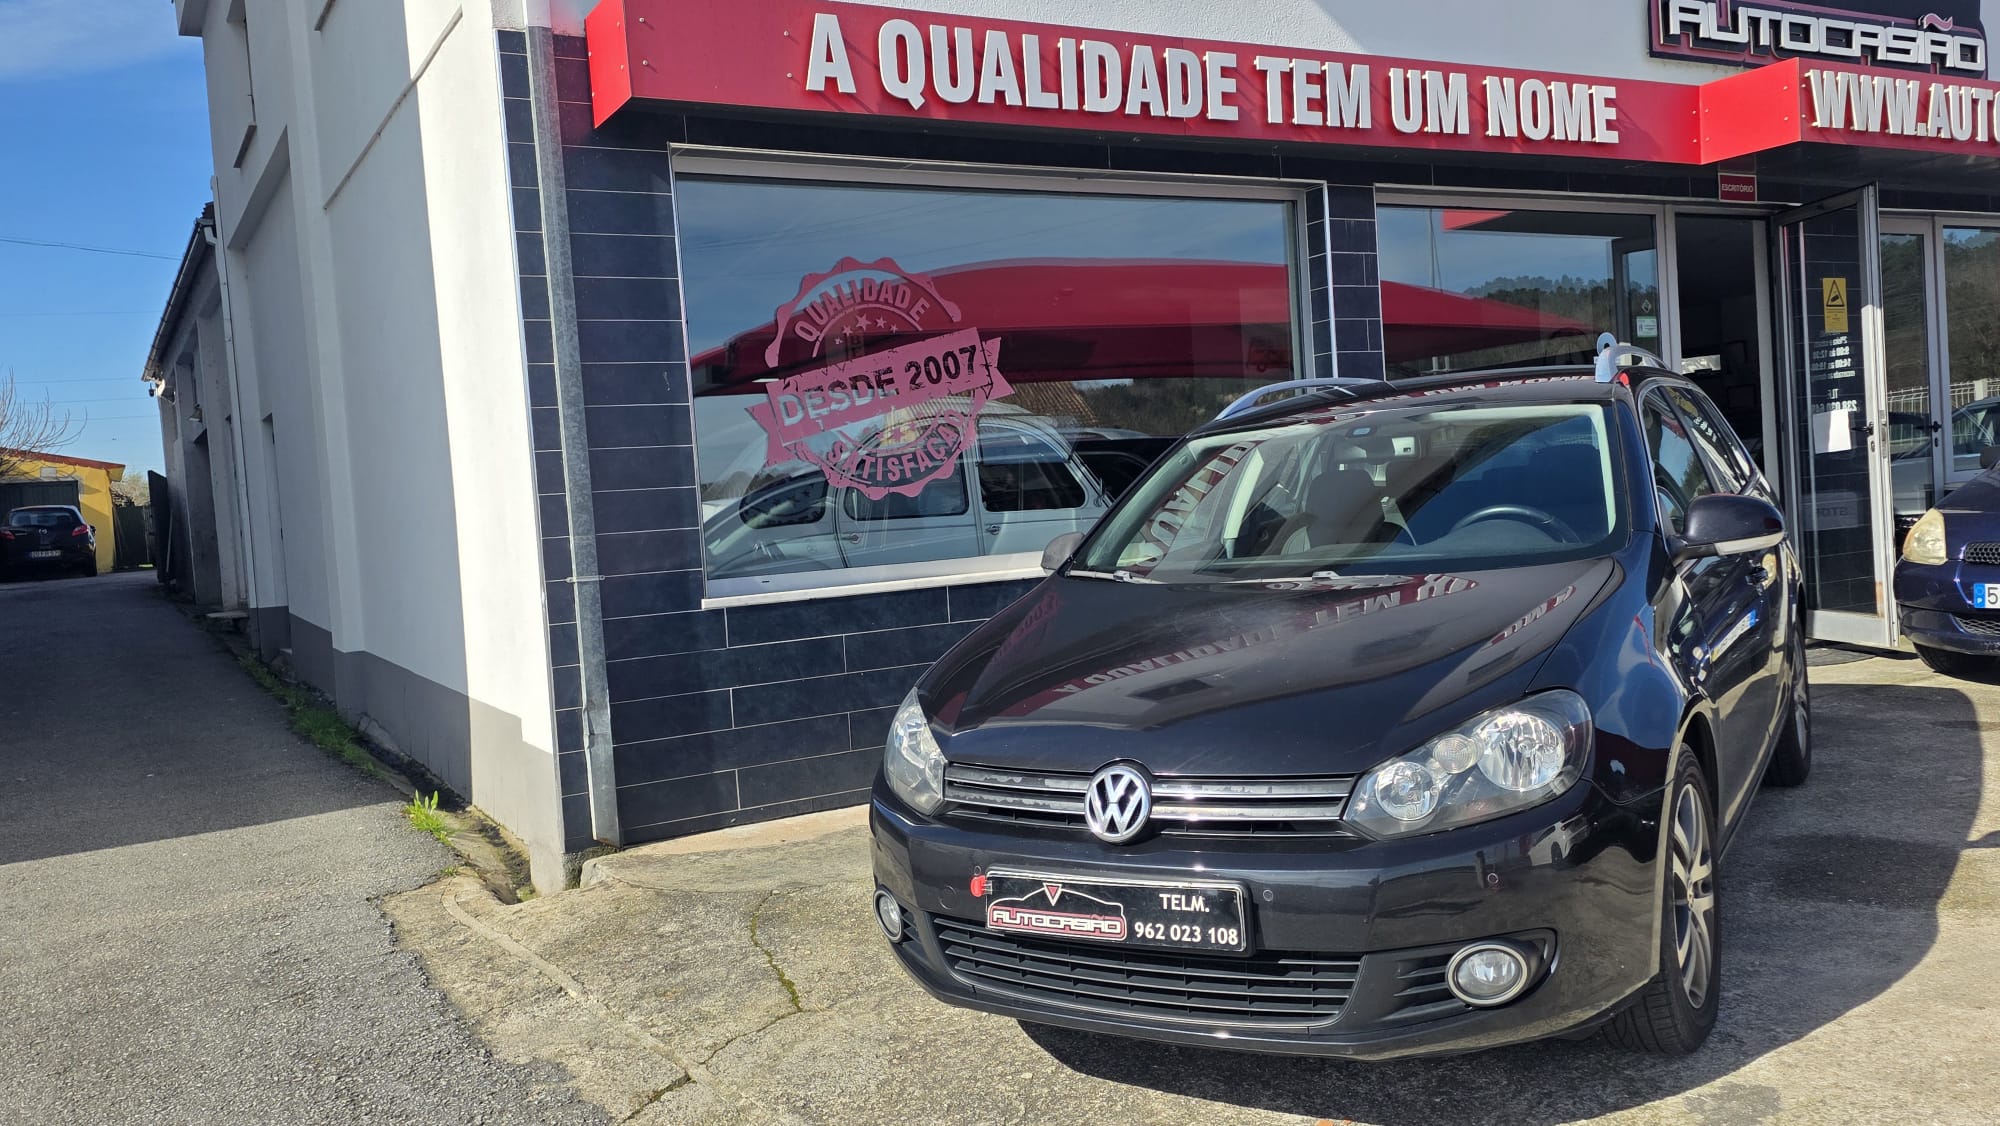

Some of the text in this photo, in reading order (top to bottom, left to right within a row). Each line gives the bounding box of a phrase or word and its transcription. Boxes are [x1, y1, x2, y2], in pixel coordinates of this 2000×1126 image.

[1669, 0, 1986, 71] AUTOCASIÃO
[806, 12, 1619, 144] A QUALIDADE TEM UM NOME
[794, 277, 930, 342] QUALIDADE
[776, 344, 977, 427] DESDE 2007
[992, 911, 1121, 934] AUTOCASIÃO
[1134, 921, 1239, 946] 962 023 108
[1158, 893, 1210, 913] TELM.
